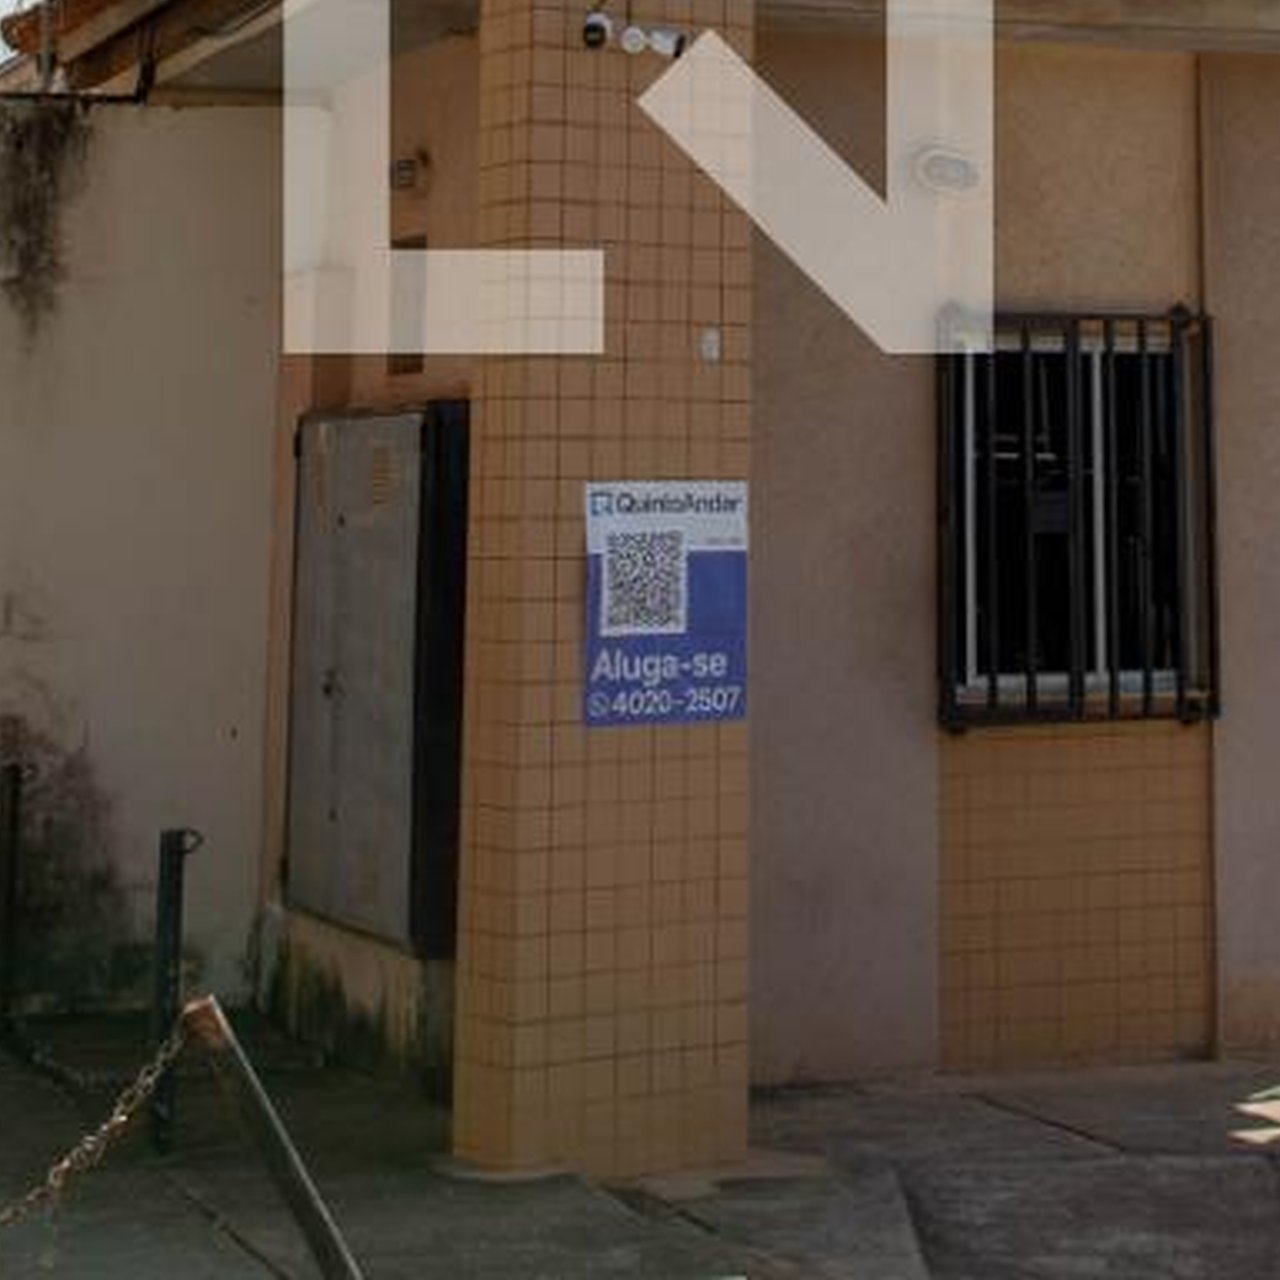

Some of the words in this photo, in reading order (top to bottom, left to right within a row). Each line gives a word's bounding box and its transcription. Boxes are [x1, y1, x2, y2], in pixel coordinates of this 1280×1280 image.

[616, 492, 742, 515] QuintoAndar
[590, 649, 728, 686] Aluga-se
[611, 686, 741, 716] 4020-2507
